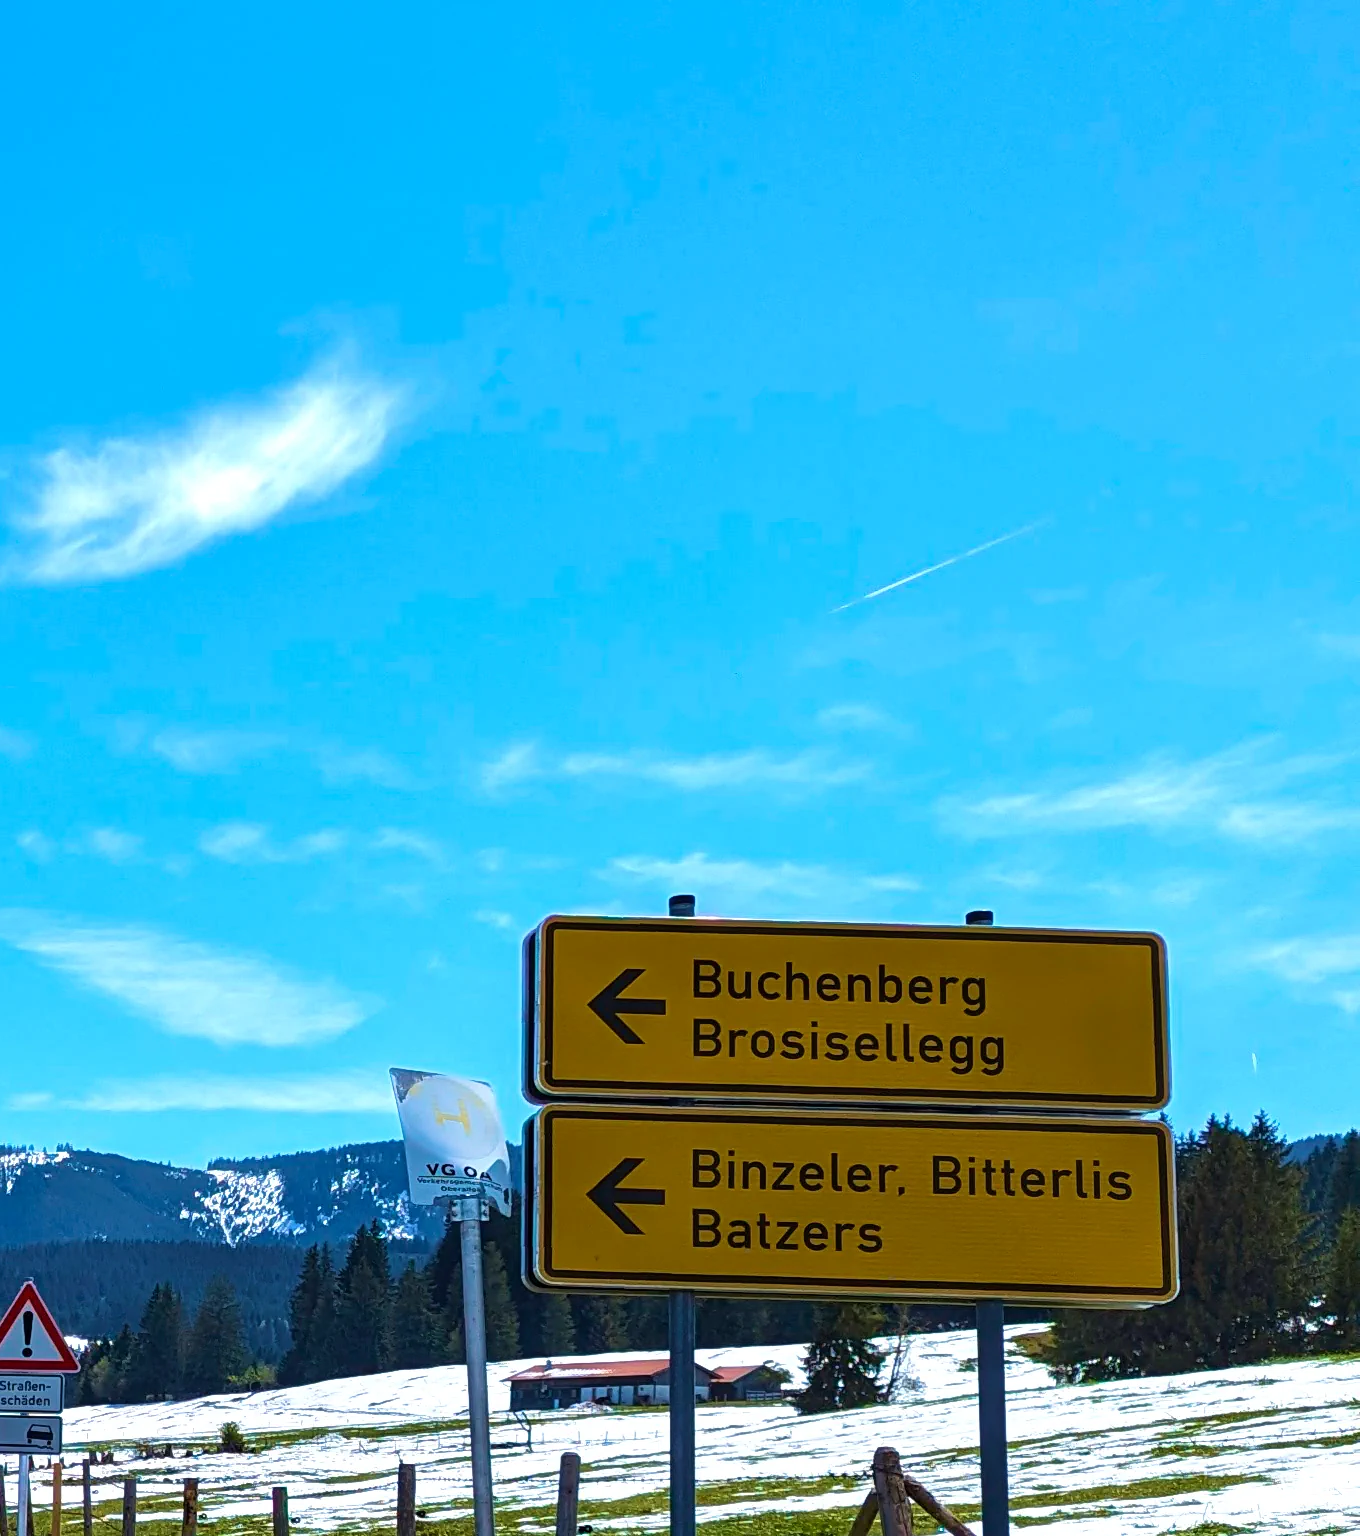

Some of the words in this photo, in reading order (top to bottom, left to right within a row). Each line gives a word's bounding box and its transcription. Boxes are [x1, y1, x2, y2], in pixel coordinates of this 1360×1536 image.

[692, 959, 988, 1017] Buchenberg
[692, 1018, 1006, 1076] Brosisellegg
[432, 1098, 471, 1136] H
[417, 1177, 503, 1193] Verkehrsgemeschaft
[426, 1163, 456, 1176] VG
[463, 1165, 493, 1182] OA
[691, 1149, 907, 1197] Binzeler,
[931, 1155, 1133, 1201] Bitterlis
[692, 1209, 884, 1252] Batzers
[0, 1394, 51, 1407] schäden
